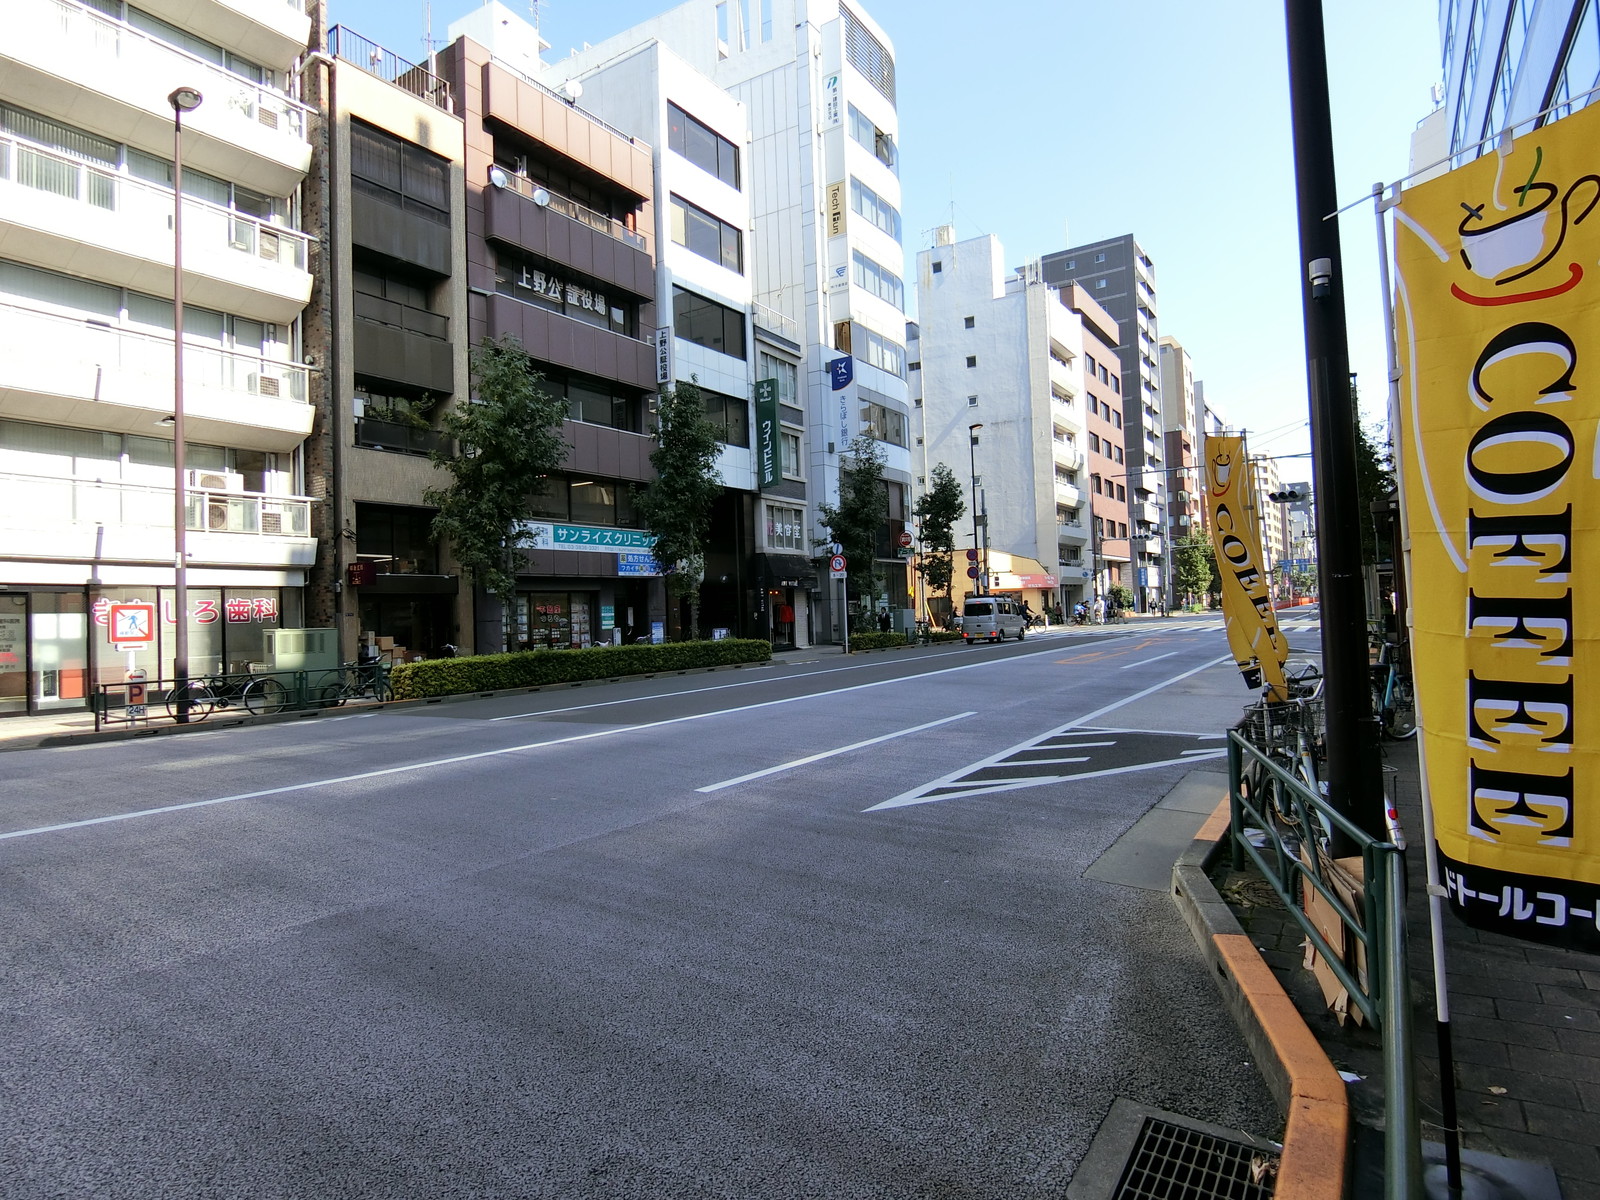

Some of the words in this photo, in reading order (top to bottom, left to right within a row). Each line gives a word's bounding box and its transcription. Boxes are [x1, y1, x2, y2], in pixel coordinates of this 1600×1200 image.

[831, 185, 840, 210] Tech
[517, 265, 607, 316] 上野公証役場
[658, 330, 669, 381] 上野公証役場
[839, 395, 849, 446] きらぼし銀行
[557, 528, 658, 546] サンライズクリニック
[1466, 321, 1577, 840] COFFEE
[128, 705, 145, 715] 24H
[129, 685, 143, 702] P
[1444, 866, 1600, 932] ドトールコー
